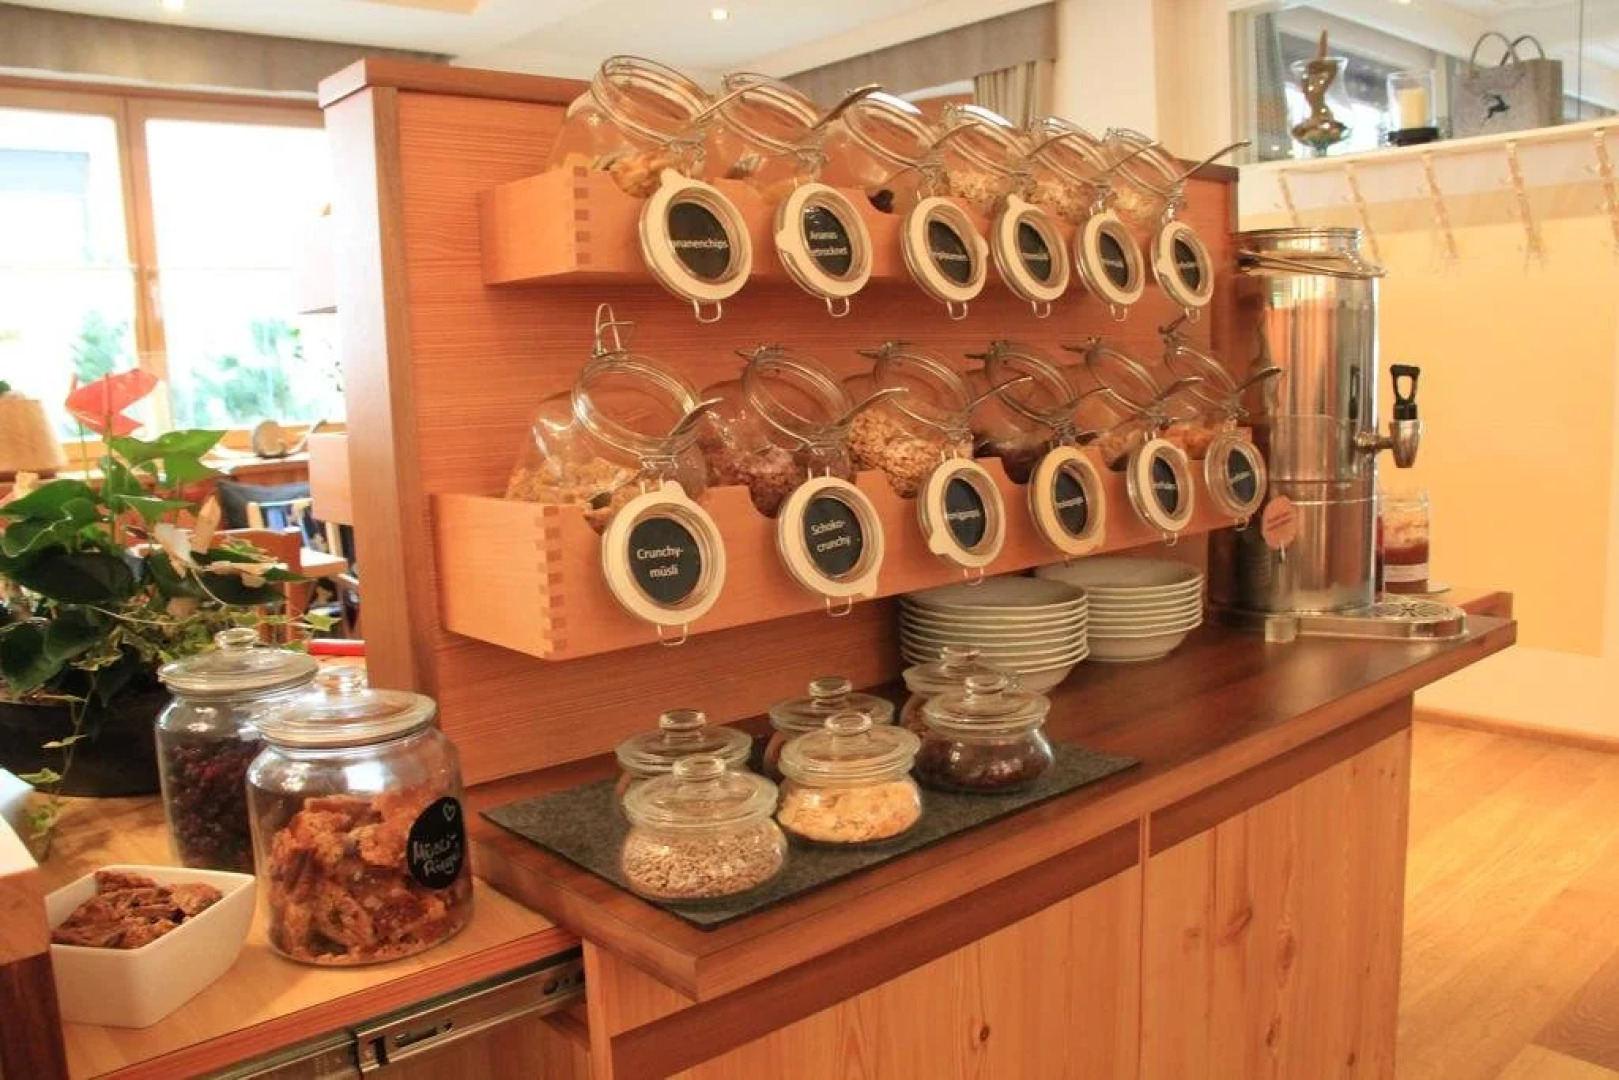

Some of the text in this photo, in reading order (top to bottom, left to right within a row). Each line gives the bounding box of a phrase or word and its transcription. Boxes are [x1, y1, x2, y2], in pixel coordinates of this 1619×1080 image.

[810, 519, 846, 535] Schoko-
[816, 535, 851, 553] crunchy
[636, 545, 684, 560] Crunchy-
[649, 564, 679, 578] müsli
